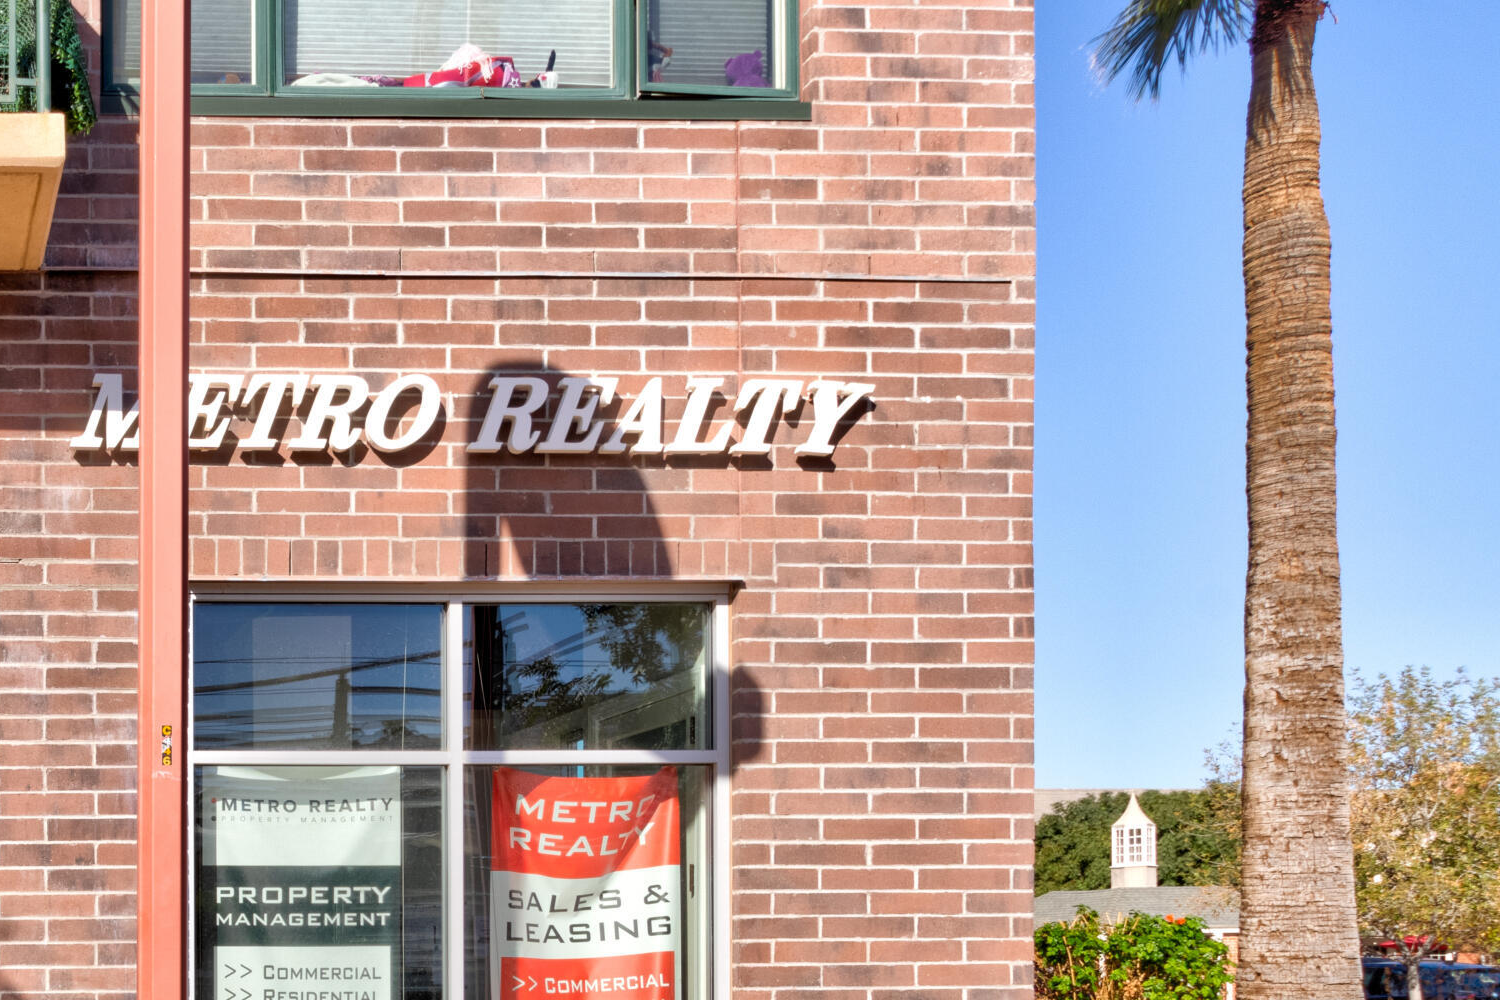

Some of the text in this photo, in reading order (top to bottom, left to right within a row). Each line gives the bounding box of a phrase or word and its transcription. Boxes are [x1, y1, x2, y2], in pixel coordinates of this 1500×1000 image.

[70, 373, 876, 457] METRO REALTY
[222, 798, 393, 812] METRO REALTY
[515, 794, 655, 823] METRO
[509, 822, 655, 856] REALTY
[216, 886, 392, 904] PROPERTY
[508, 885, 670, 913] SALES &
[216, 913, 391, 926] MANAGEMENT
[506, 916, 671, 943] LEASING
[263, 965, 382, 980] COMMERCIAL
[545, 974, 670, 994] COMMERCIAL
